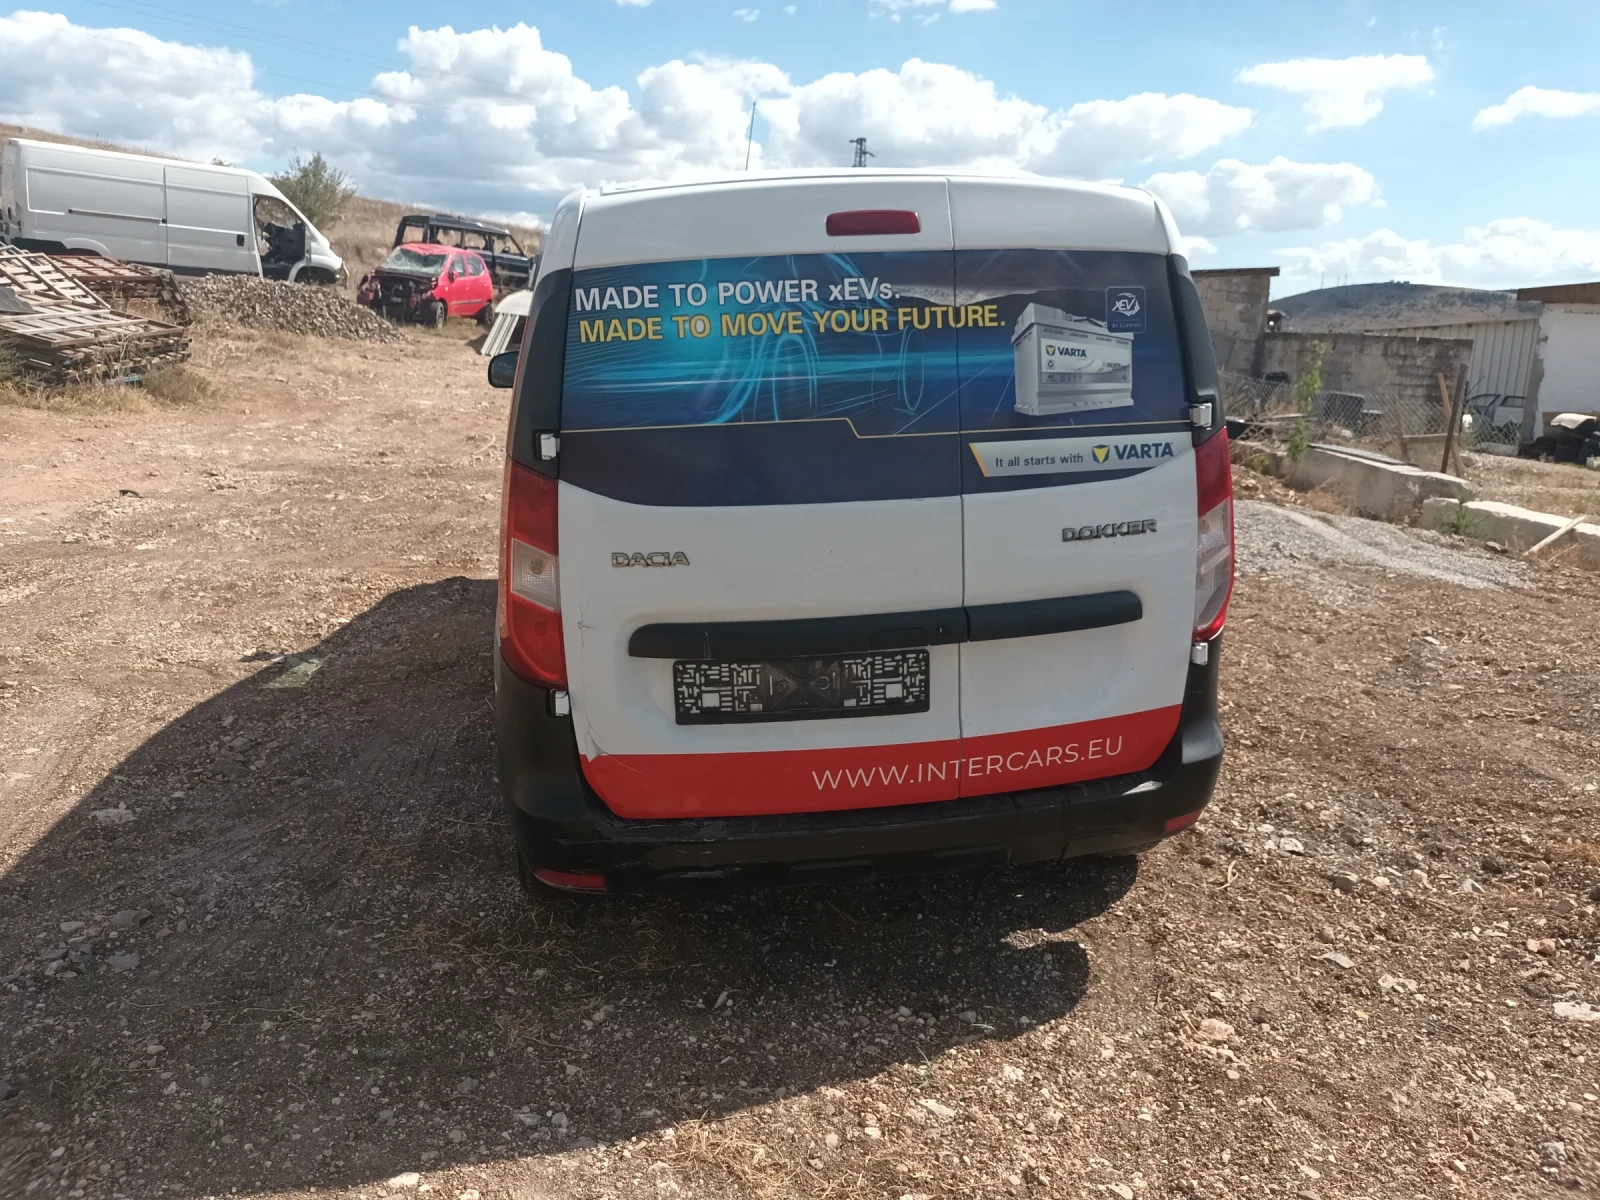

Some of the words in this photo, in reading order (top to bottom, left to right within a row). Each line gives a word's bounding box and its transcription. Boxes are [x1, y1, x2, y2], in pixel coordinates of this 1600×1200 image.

[575, 285, 660, 312] MADE
[668, 283, 707, 307] TO
[718, 278, 819, 305] POWER
[829, 277, 900, 301] xEVs.
[579, 317, 663, 343] MADE
[672, 314, 711, 338] TO
[721, 311, 804, 337] MOVE
[813, 309, 889, 333] YOUR
[898, 304, 1006, 330] FUTURE.
[1057, 346, 1087, 358] VARTA
[995, 457, 1004, 468] It
[1007, 456, 1020, 467] all
[1023, 455, 1056, 467] starts
[1060, 453, 1084, 464] with
[1113, 442, 1174, 461] VARTA
[1062, 518, 1158, 543] DOKKER
[611, 551, 691, 568] DACIA
[812, 735, 1123, 790] WWW.INTERCARS.EU
